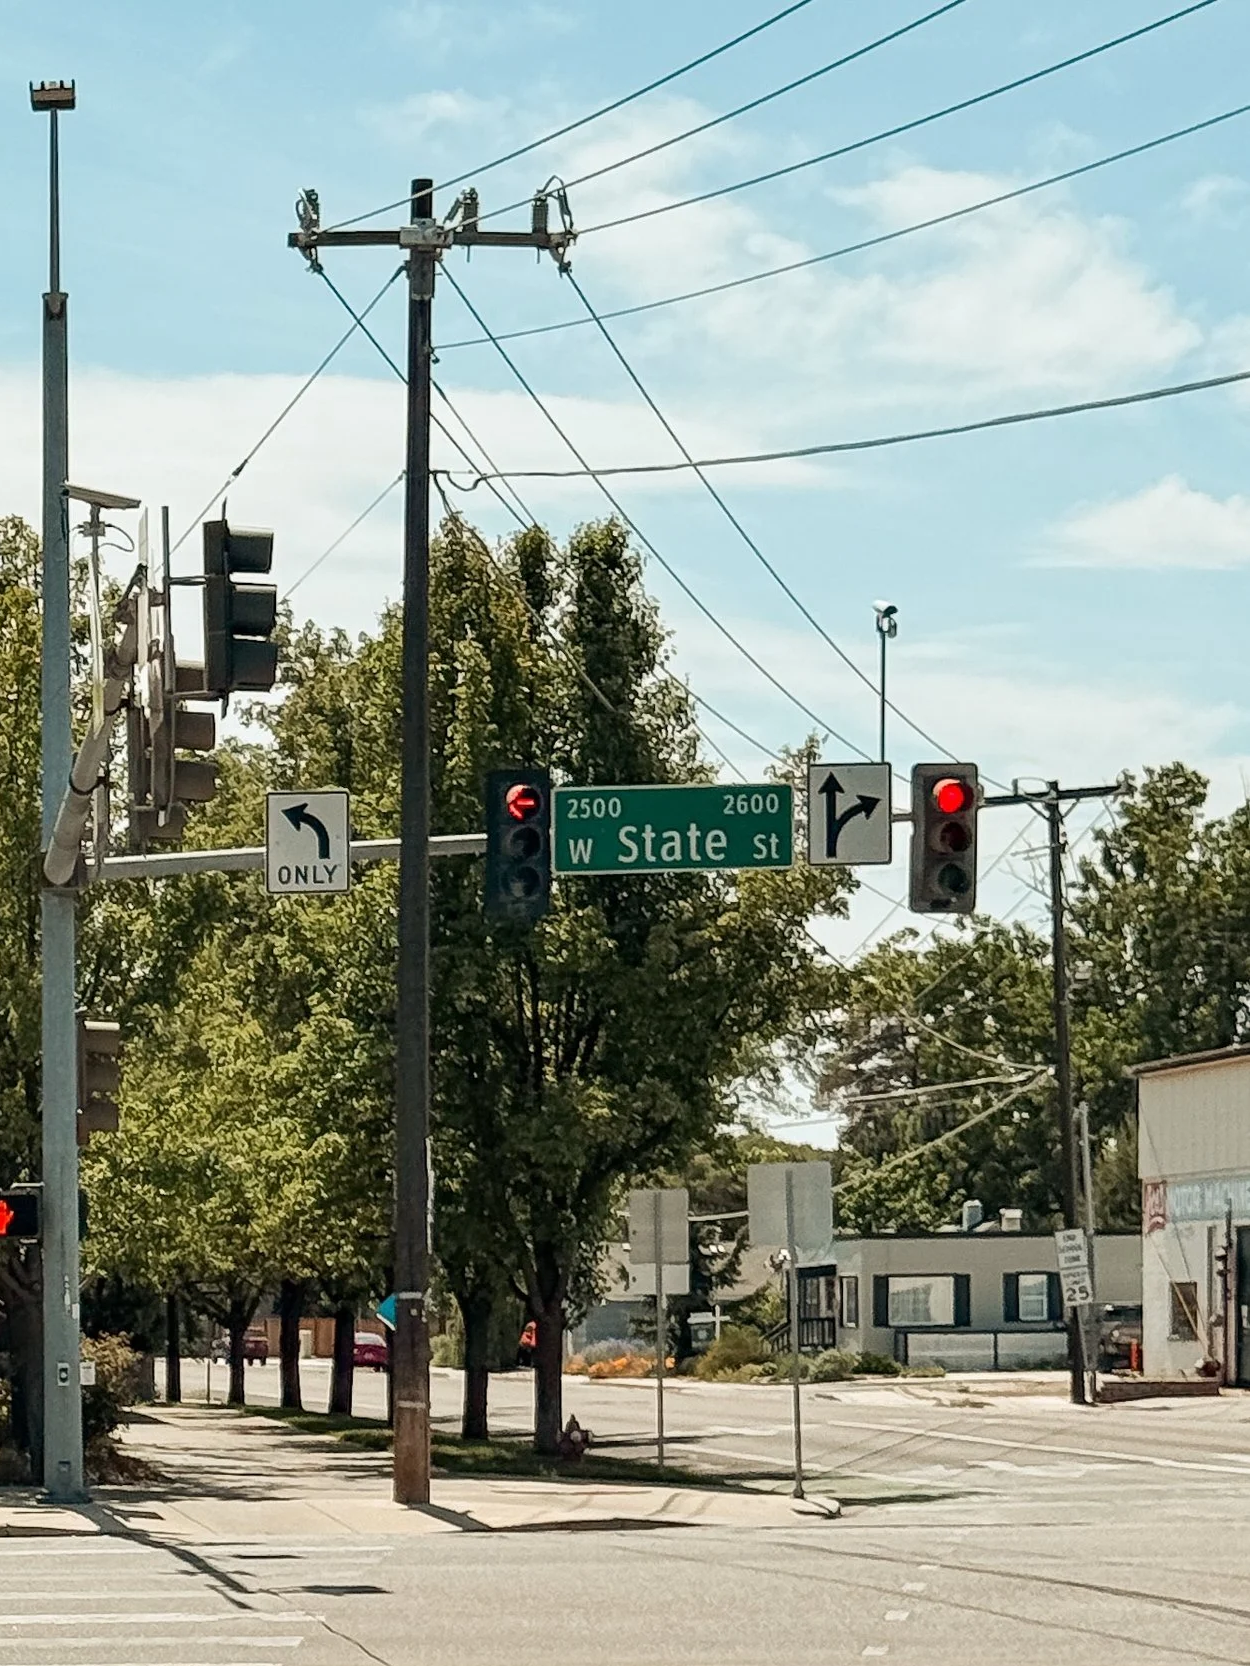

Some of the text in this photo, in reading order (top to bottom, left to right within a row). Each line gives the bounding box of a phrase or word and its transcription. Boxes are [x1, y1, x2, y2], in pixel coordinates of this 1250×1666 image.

[567, 793, 779, 819] 2500 2600
[568, 823, 779, 864] W State St
[278, 865, 337, 884] ONLY
[1066, 1286, 1089, 1302] 25
